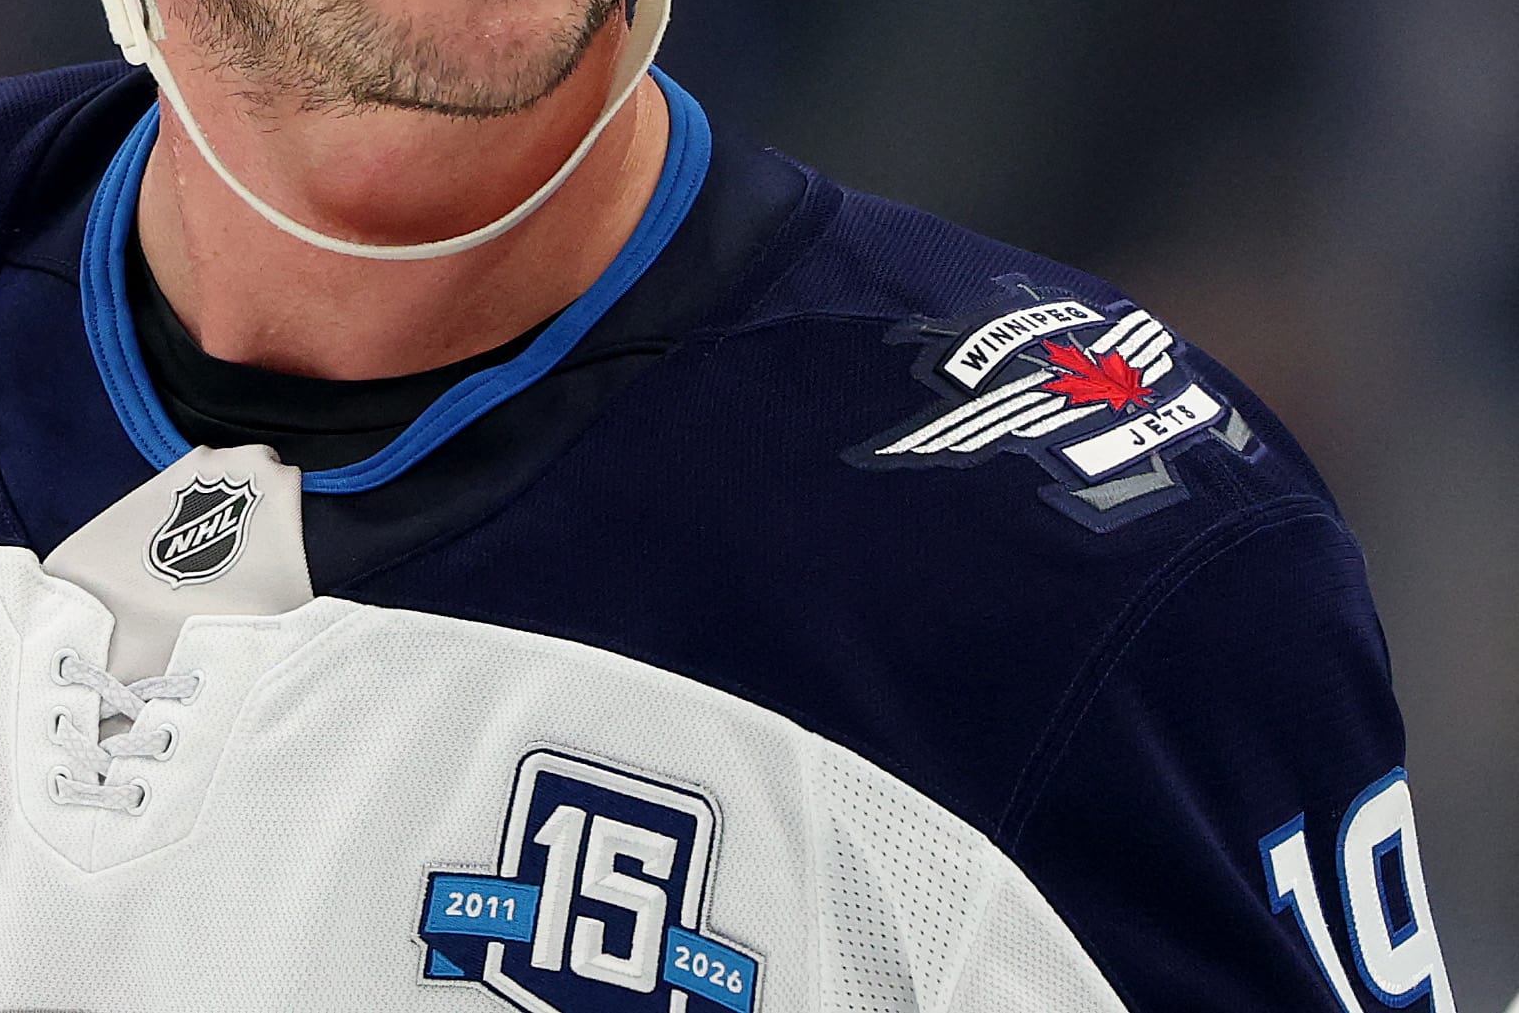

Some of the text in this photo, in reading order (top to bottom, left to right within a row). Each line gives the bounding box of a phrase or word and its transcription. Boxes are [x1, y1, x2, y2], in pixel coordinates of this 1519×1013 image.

[960, 306, 1089, 372] WINNIPEG
[1131, 404, 1196, 446] JETS
[164, 505, 239, 560] NHL
[444, 891, 517, 922] 2011
[531, 805, 679, 994] 15
[1258, 765, 1460, 1013] 19
[673, 945, 744, 995] 2026
